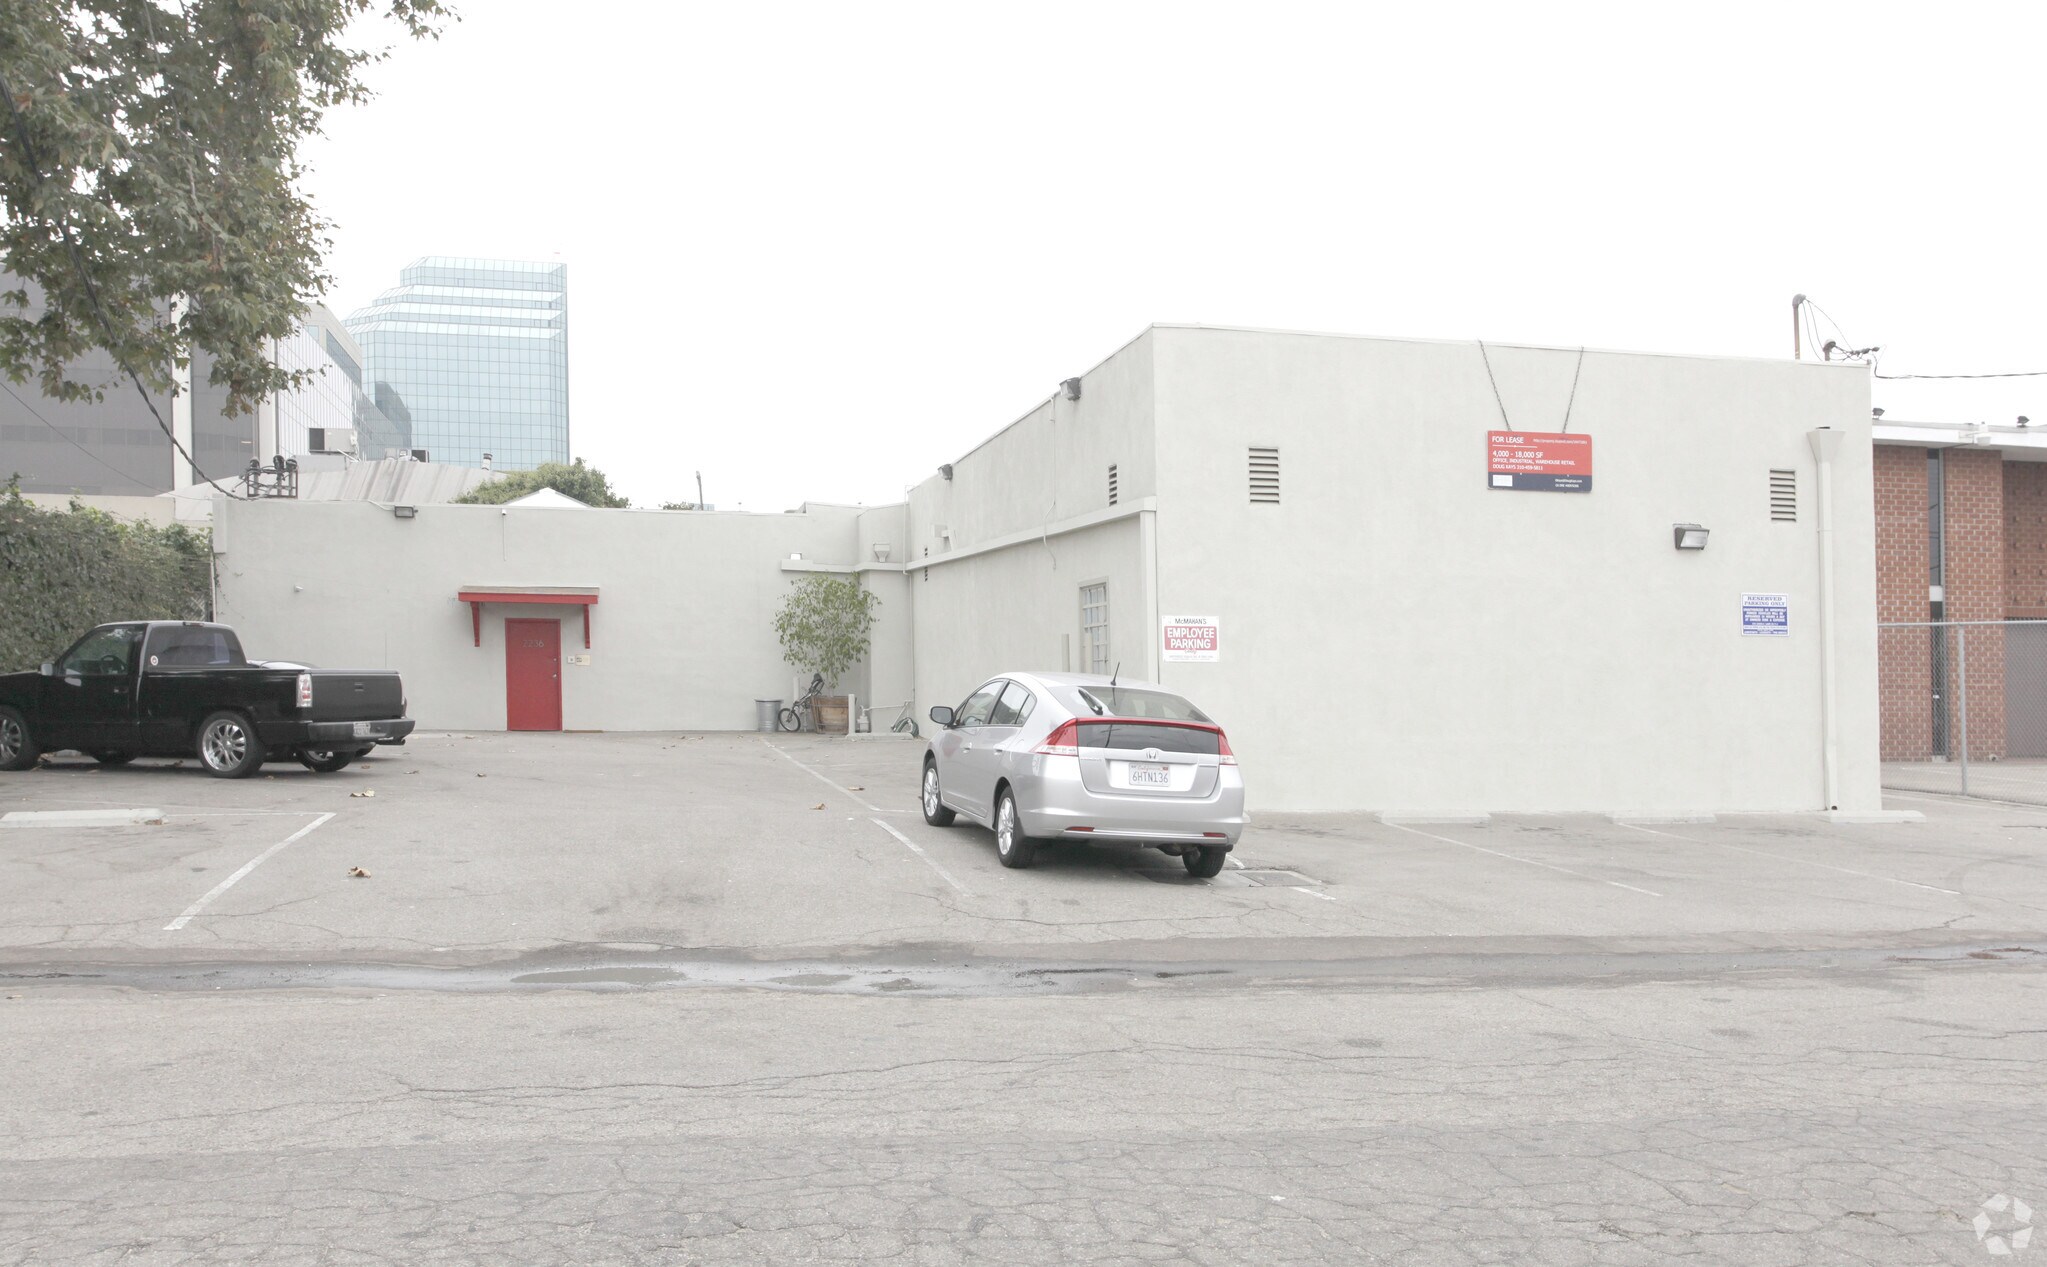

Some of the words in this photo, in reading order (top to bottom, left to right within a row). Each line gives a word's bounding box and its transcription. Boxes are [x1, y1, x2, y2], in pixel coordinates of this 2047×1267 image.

[1492, 435, 1504, 443] FOR
[1506, 436, 1524, 444] LEASE
[1492, 450, 1509, 458] 4,000
[1167, 627, 1215, 638] EMPLOYEE
[1170, 638, 1211, 649] PARKING
[1132, 771, 1168, 783] 6HTN136
